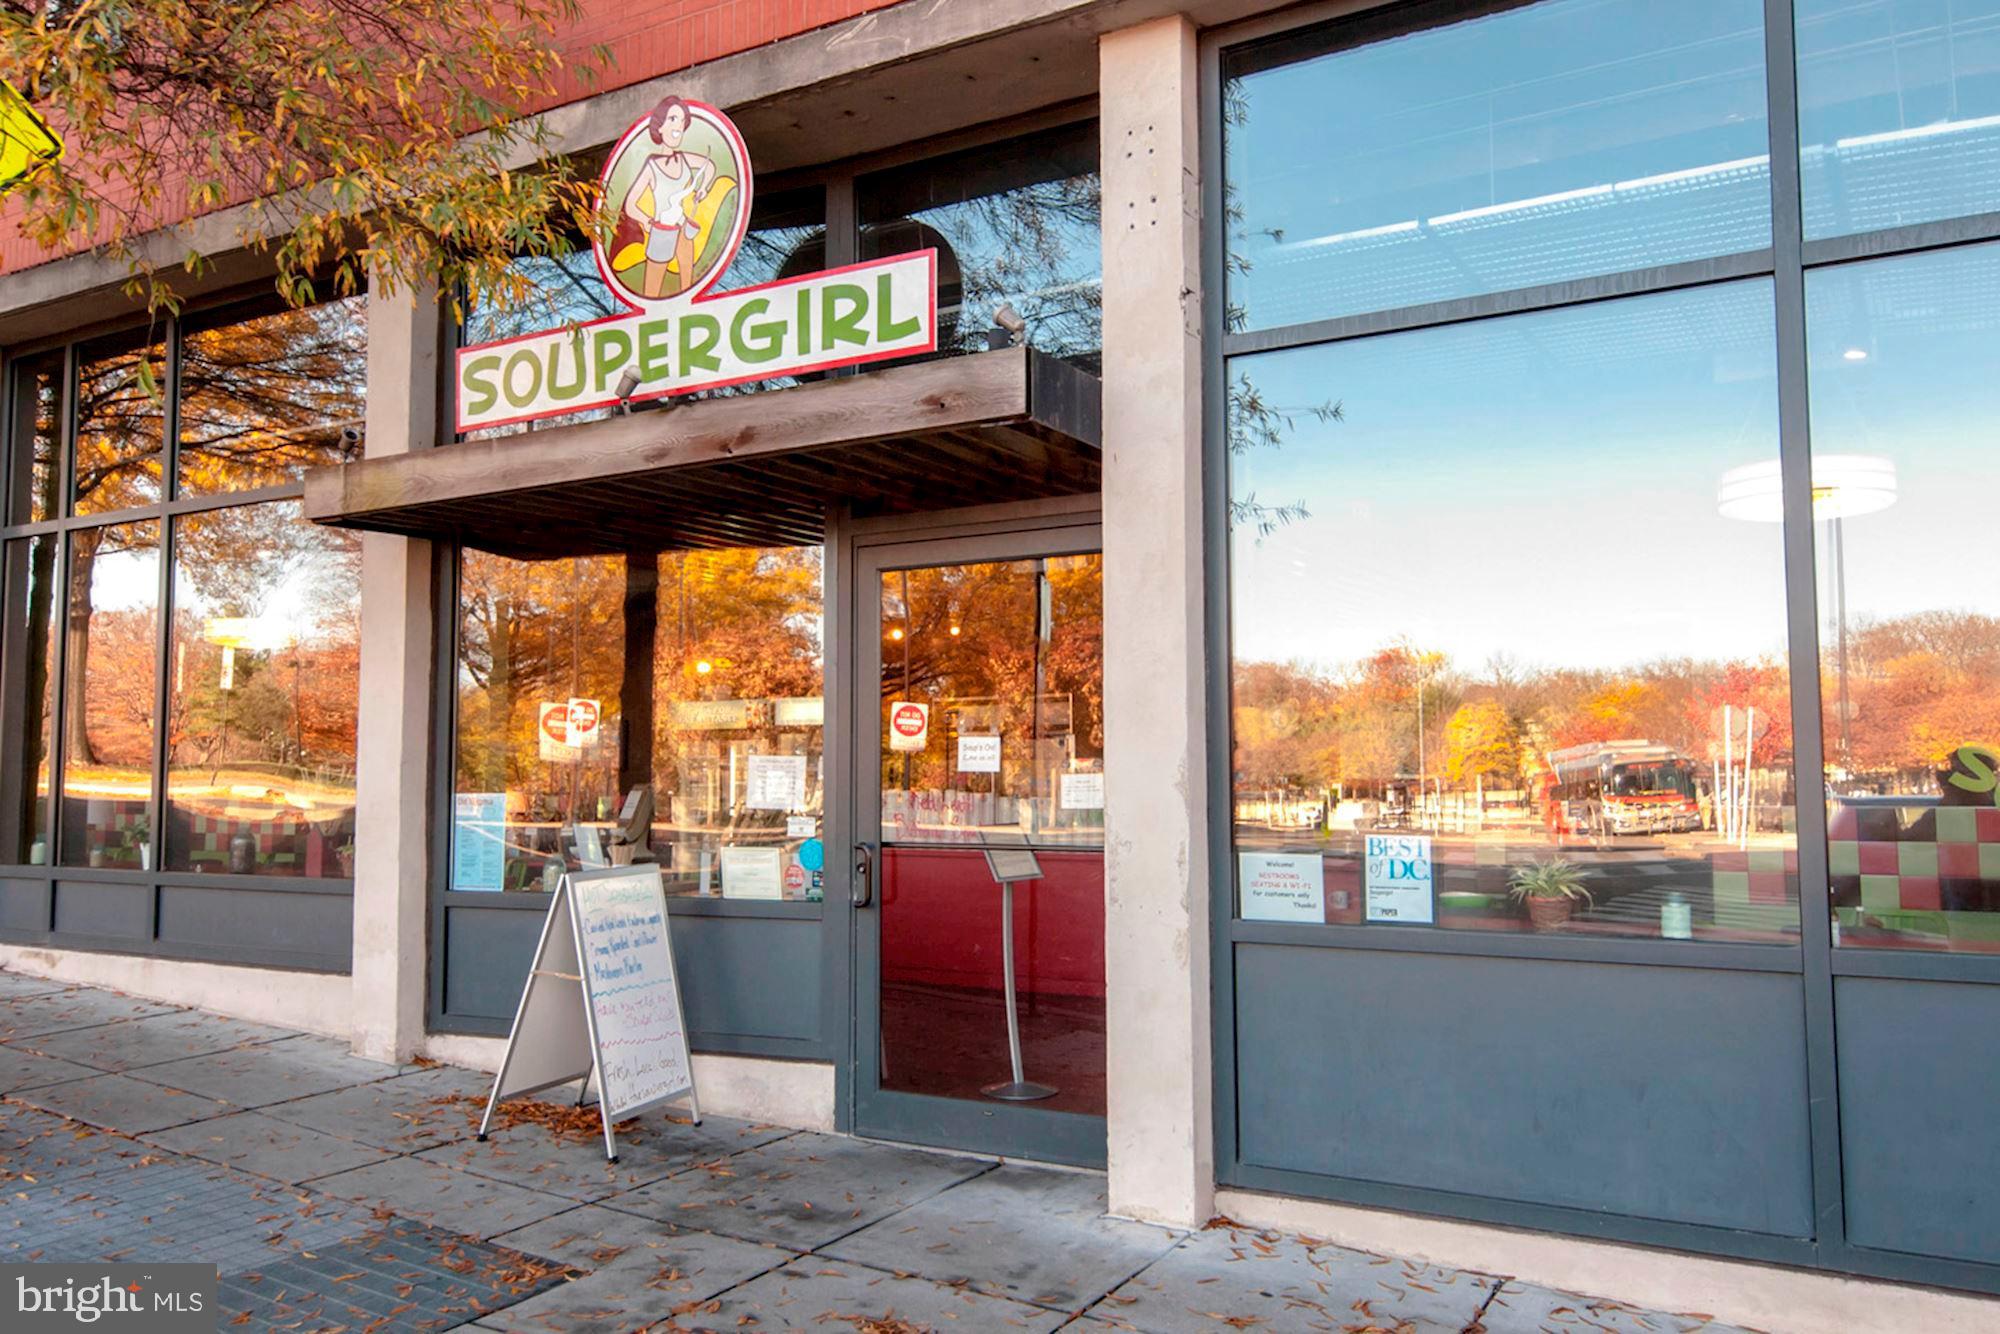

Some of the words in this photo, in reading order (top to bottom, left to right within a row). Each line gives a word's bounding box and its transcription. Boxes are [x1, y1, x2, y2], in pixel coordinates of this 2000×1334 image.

[462, 273, 921, 416] SOUPERGIRL
[1368, 836, 1425, 857] BEST
[1369, 859, 1384, 878] of
